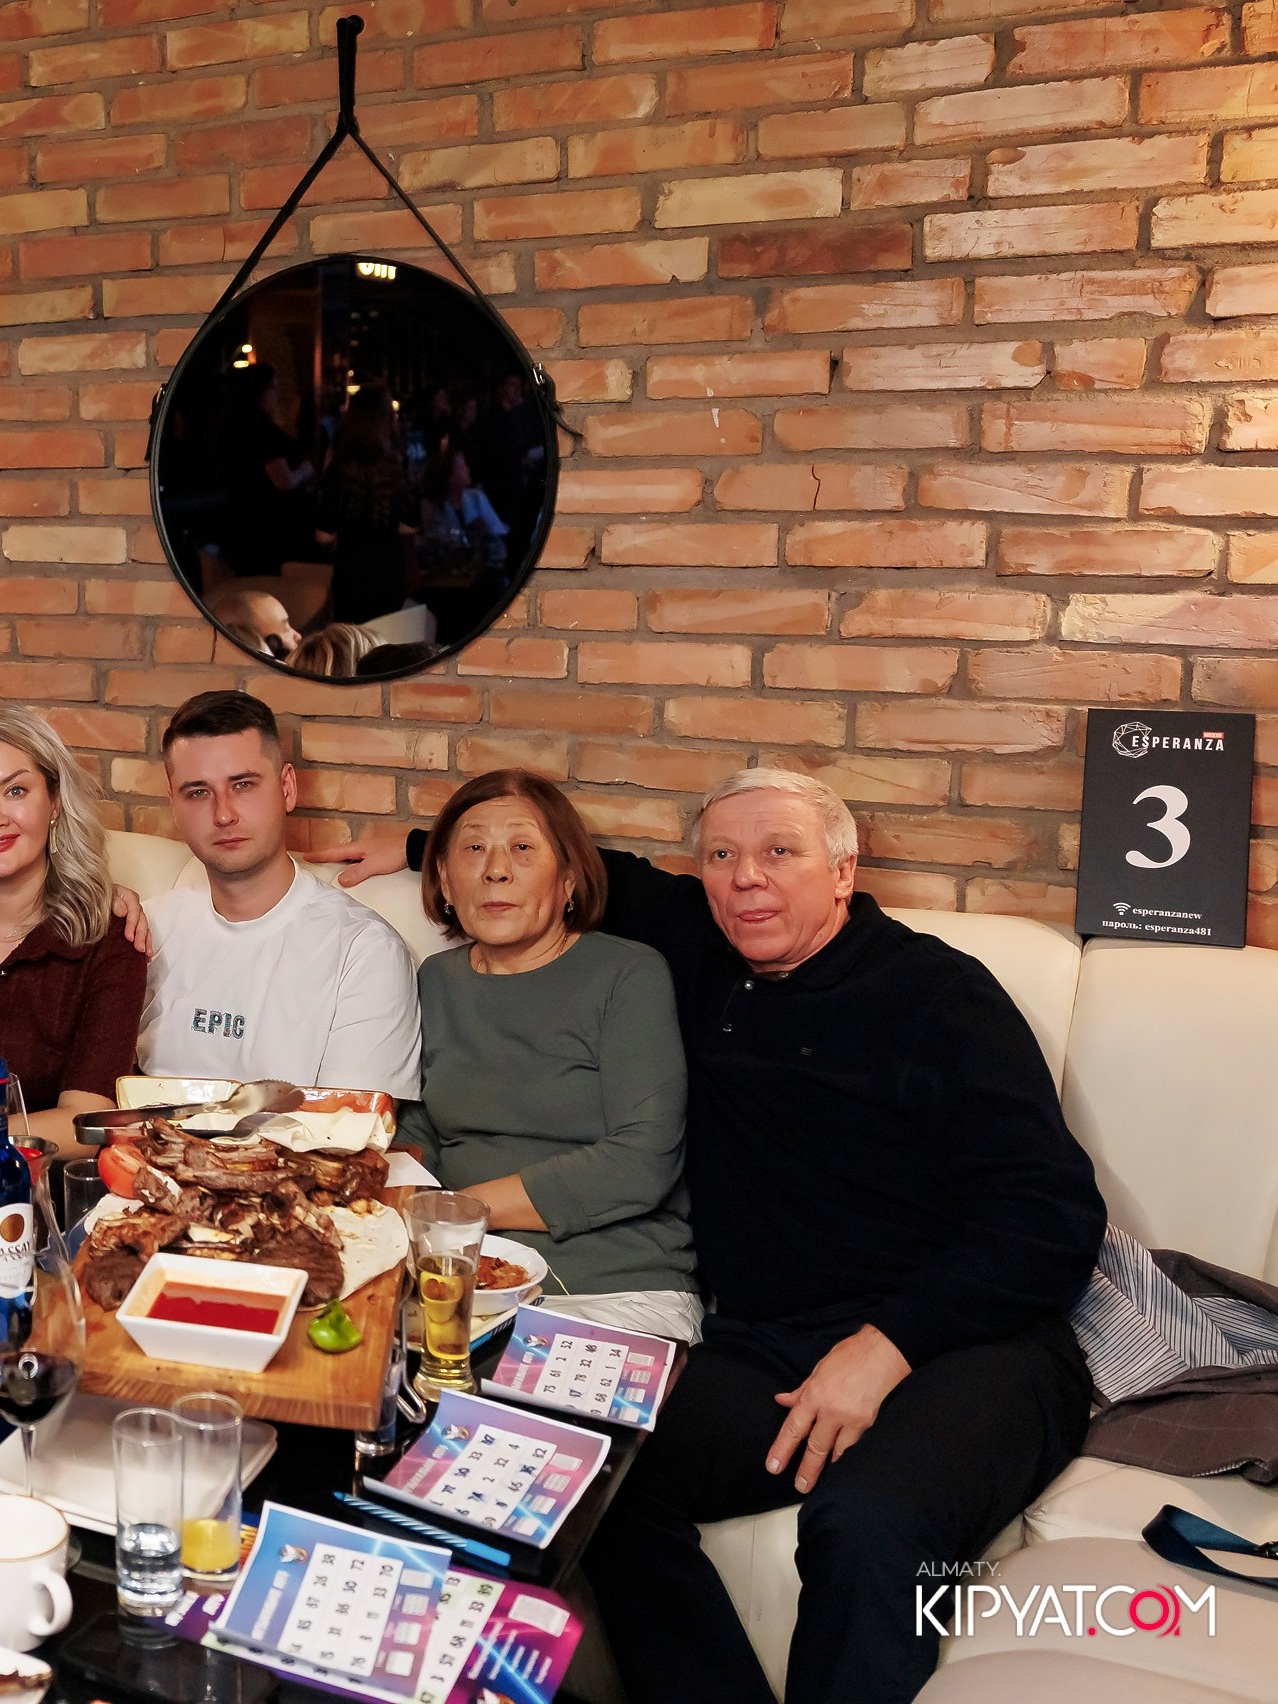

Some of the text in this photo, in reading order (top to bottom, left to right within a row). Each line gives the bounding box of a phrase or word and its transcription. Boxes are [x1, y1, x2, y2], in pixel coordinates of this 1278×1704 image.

[1132, 735, 1225, 751] ESPERANZA
[1125, 784, 1191, 869] 3
[1133, 907, 1202, 920] esperanzanew
[1102, 920, 1212, 936] пароль: esperanza481
[191, 1008, 246, 1040] EPIC
